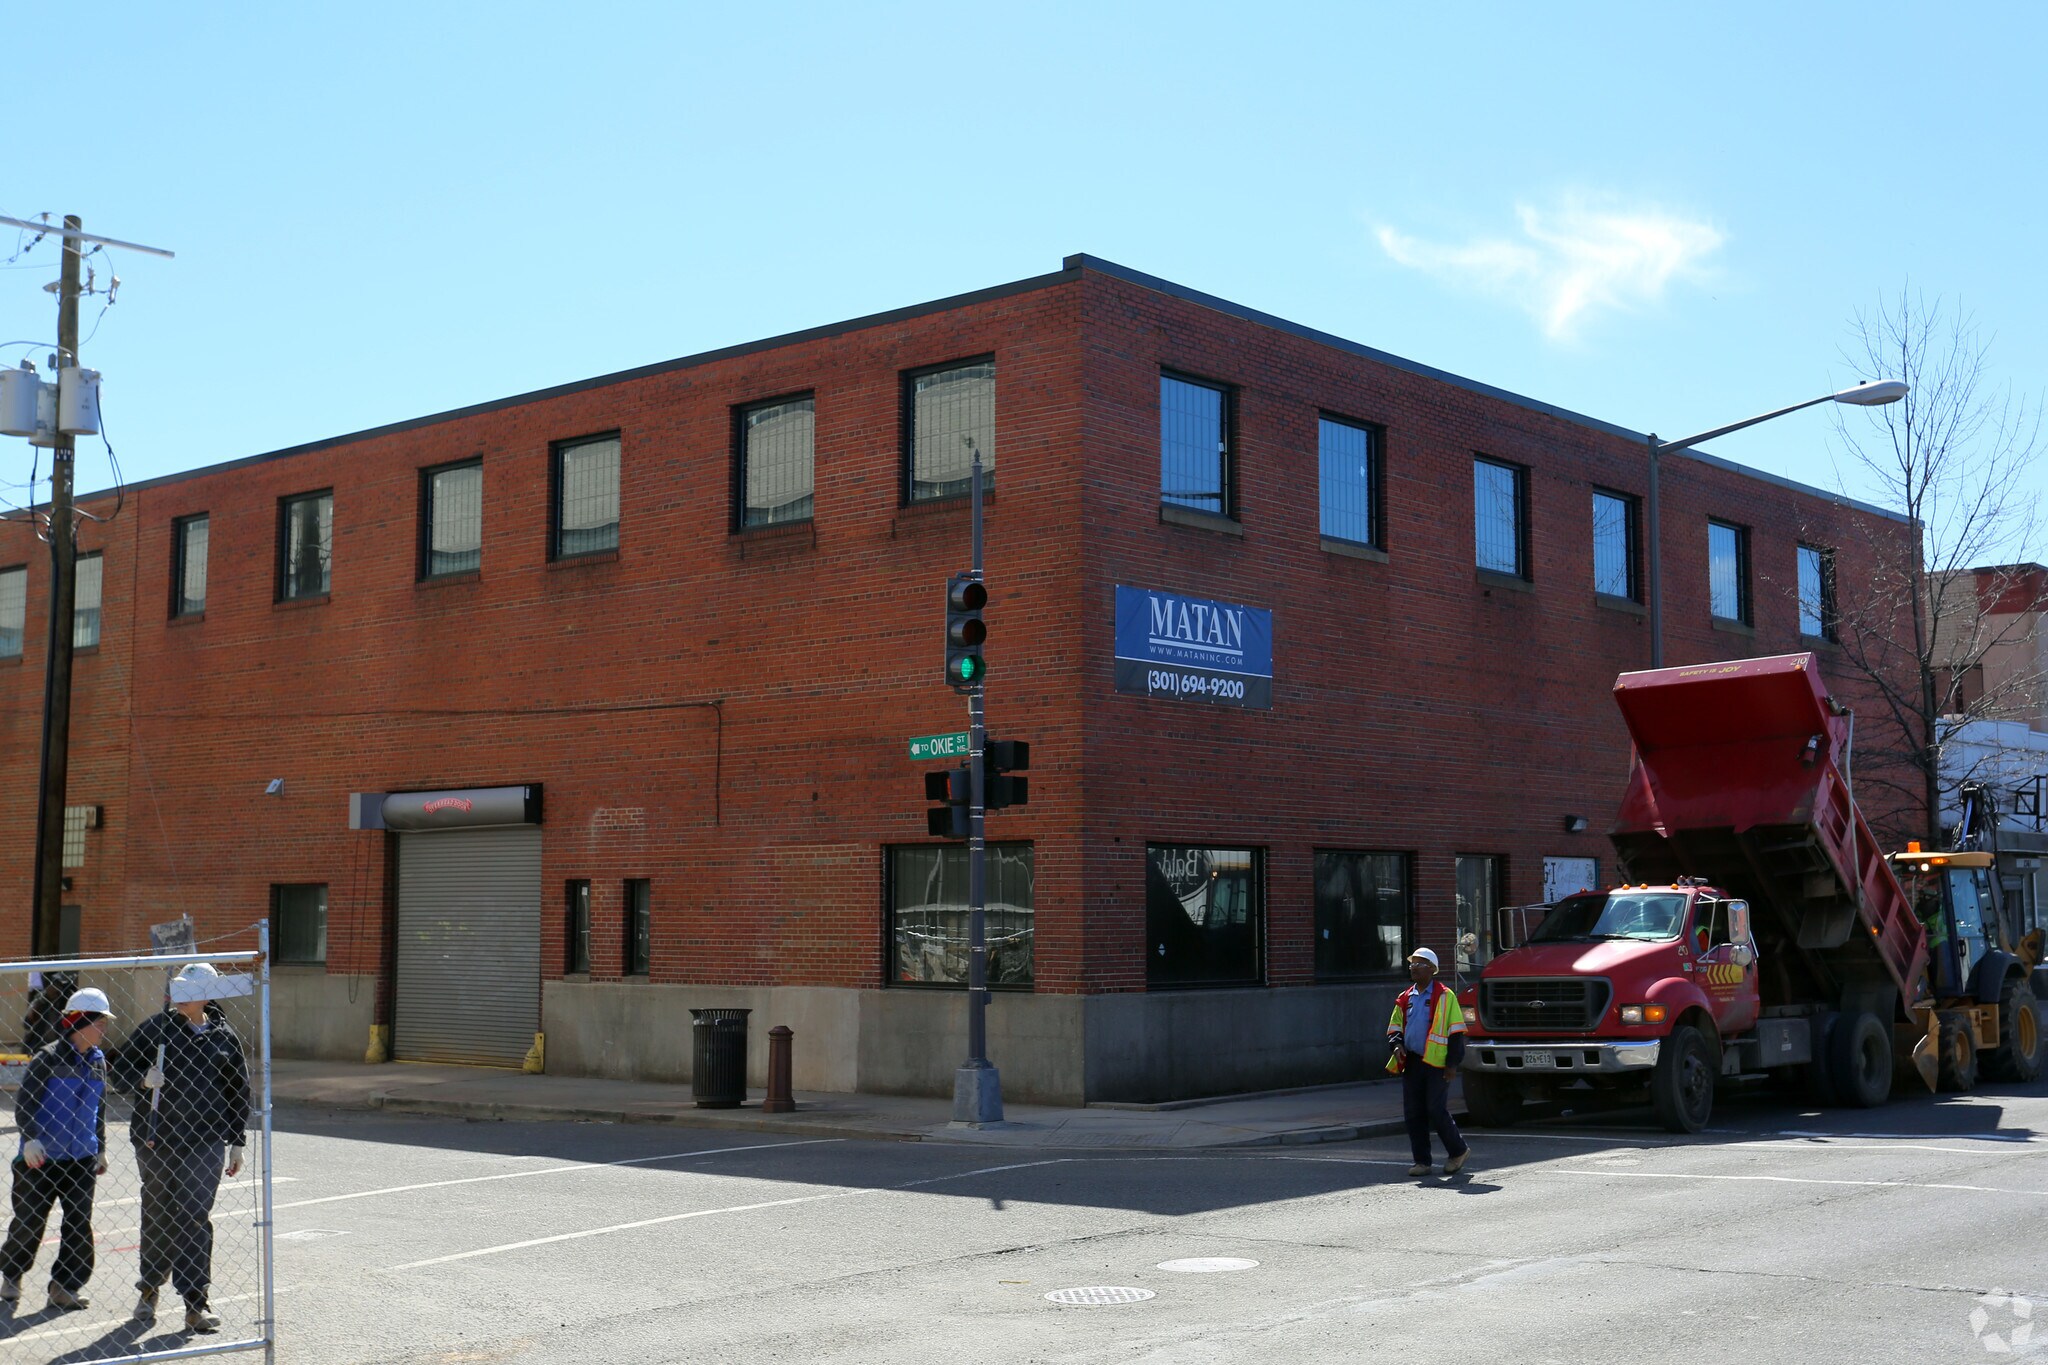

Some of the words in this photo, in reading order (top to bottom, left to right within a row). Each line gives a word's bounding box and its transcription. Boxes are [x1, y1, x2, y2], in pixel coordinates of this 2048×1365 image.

[1149, 597, 1244, 648] MATAN
[1149, 646, 1243, 665] WWW.MATANINC.COM
[1790, 657, 1808, 666] 210
[1679, 668, 1709, 677] SAFETY
[1718, 665, 1742, 674] JOY
[1147, 670, 1180, 696] (301)
[1181, 674, 1244, 699] 694-9200
[930, 738, 954, 755] OKIE
